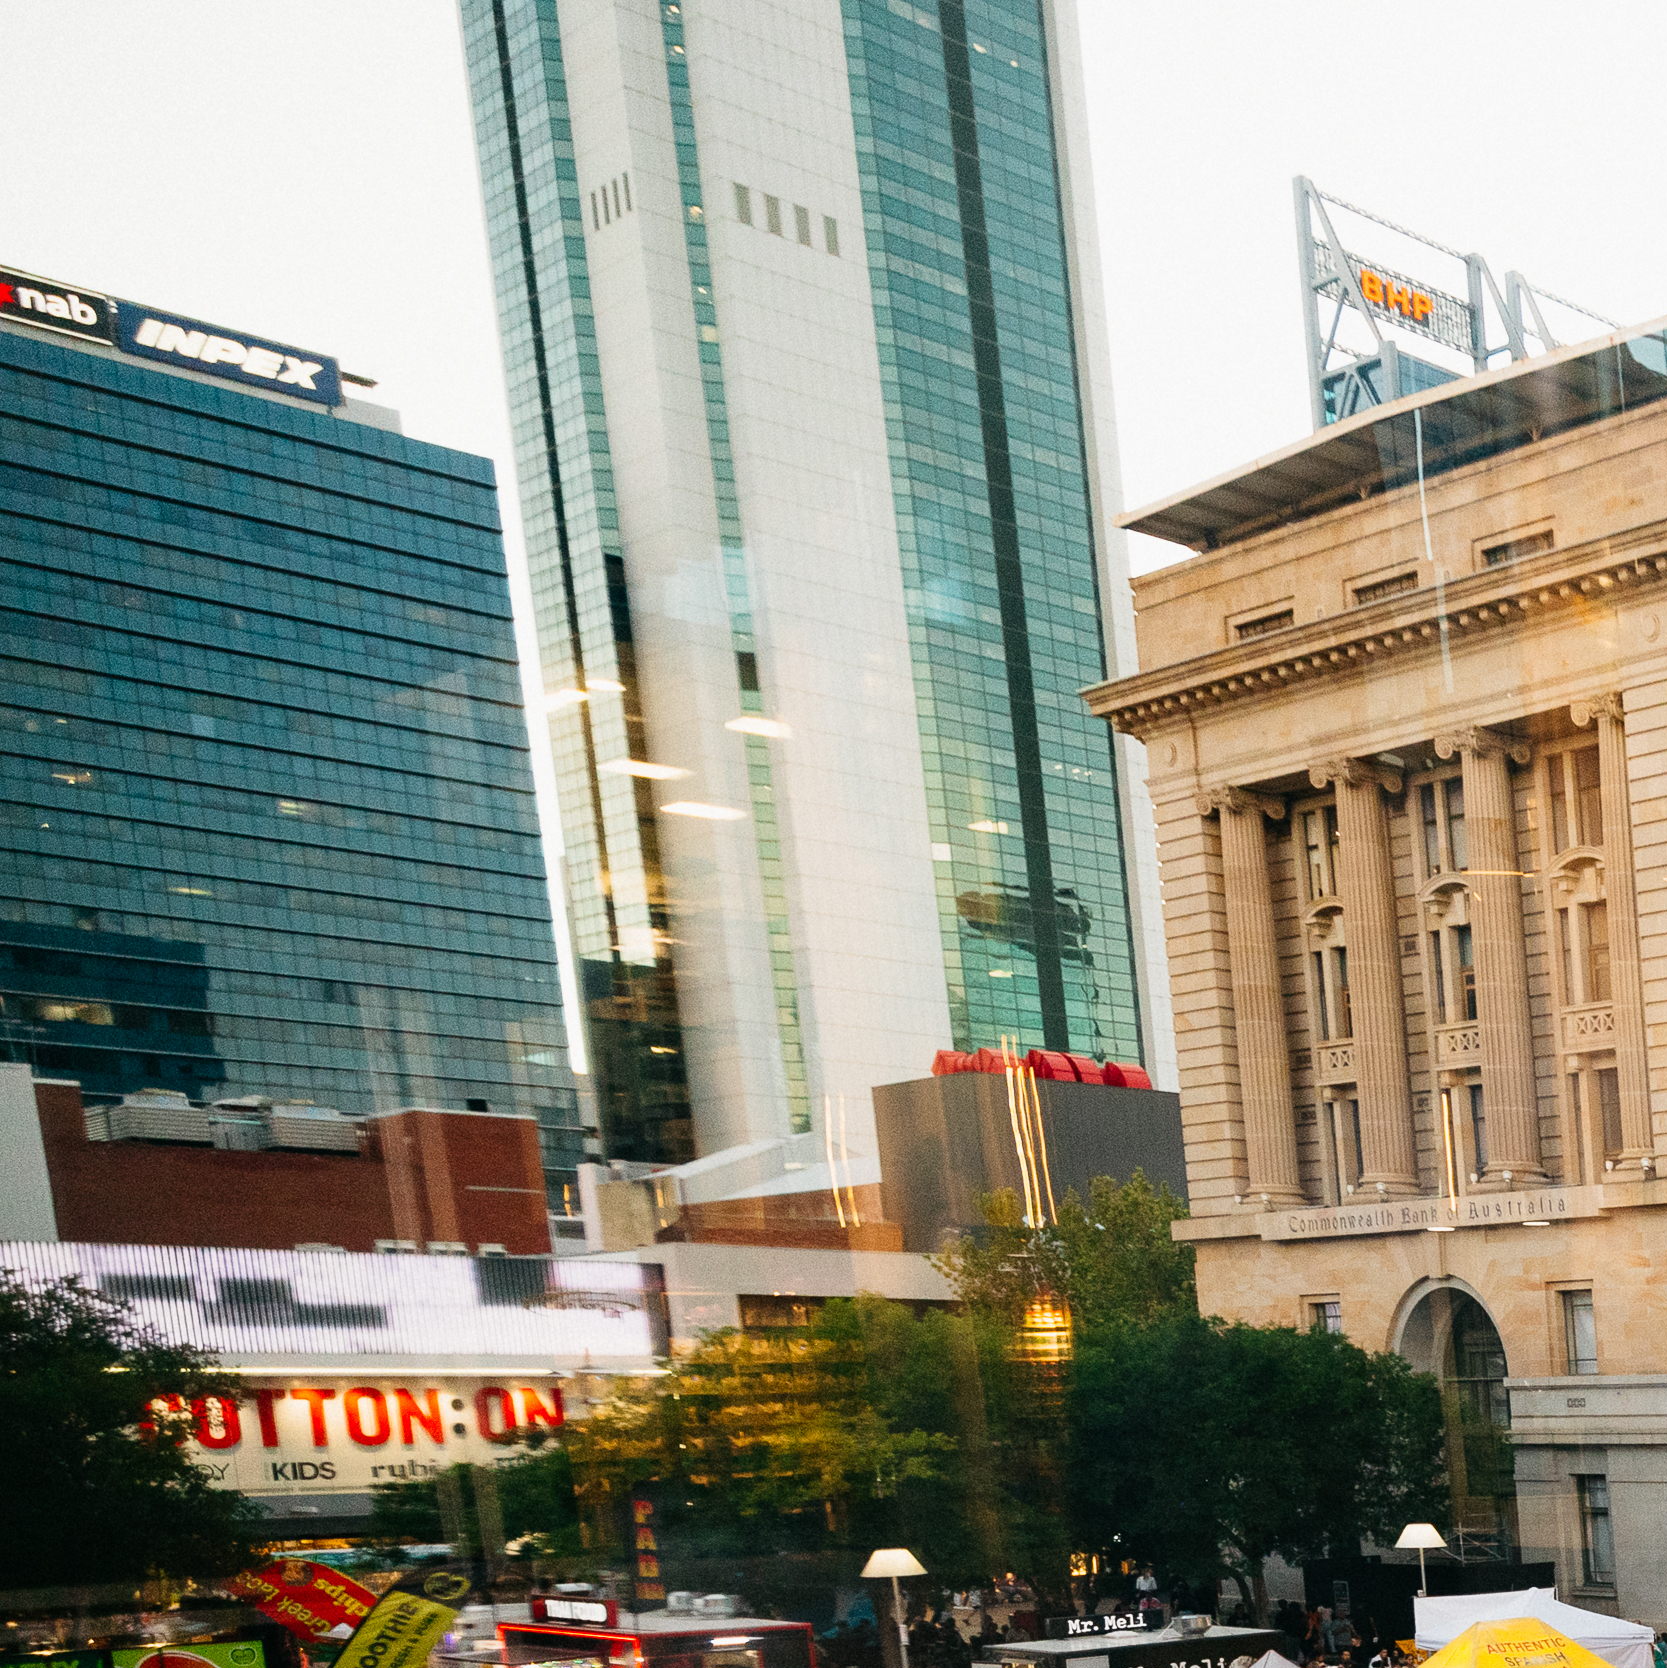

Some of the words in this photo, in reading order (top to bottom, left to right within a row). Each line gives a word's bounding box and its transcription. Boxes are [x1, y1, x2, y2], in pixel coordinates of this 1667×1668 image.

[17, 286, 98, 326] nab
[1361, 269, 1433, 321] BHP
[135, 318, 323, 390] INPEX
[1289, 1213, 1394, 1233] Commonwealth
[1401, 1207, 1438, 1226] Bank
[1469, 1197, 1566, 1219] Australia
[272, 1461, 337, 1481] KIDS
[277, 1596, 331, 1634] Greek
[313, 1578, 369, 1616] chips
[1068, 1619, 1099, 1634] Mr.
[1104, 1613, 1147, 1629] Meli
[1487, 1637, 1566, 1655] AUTHENTIC
